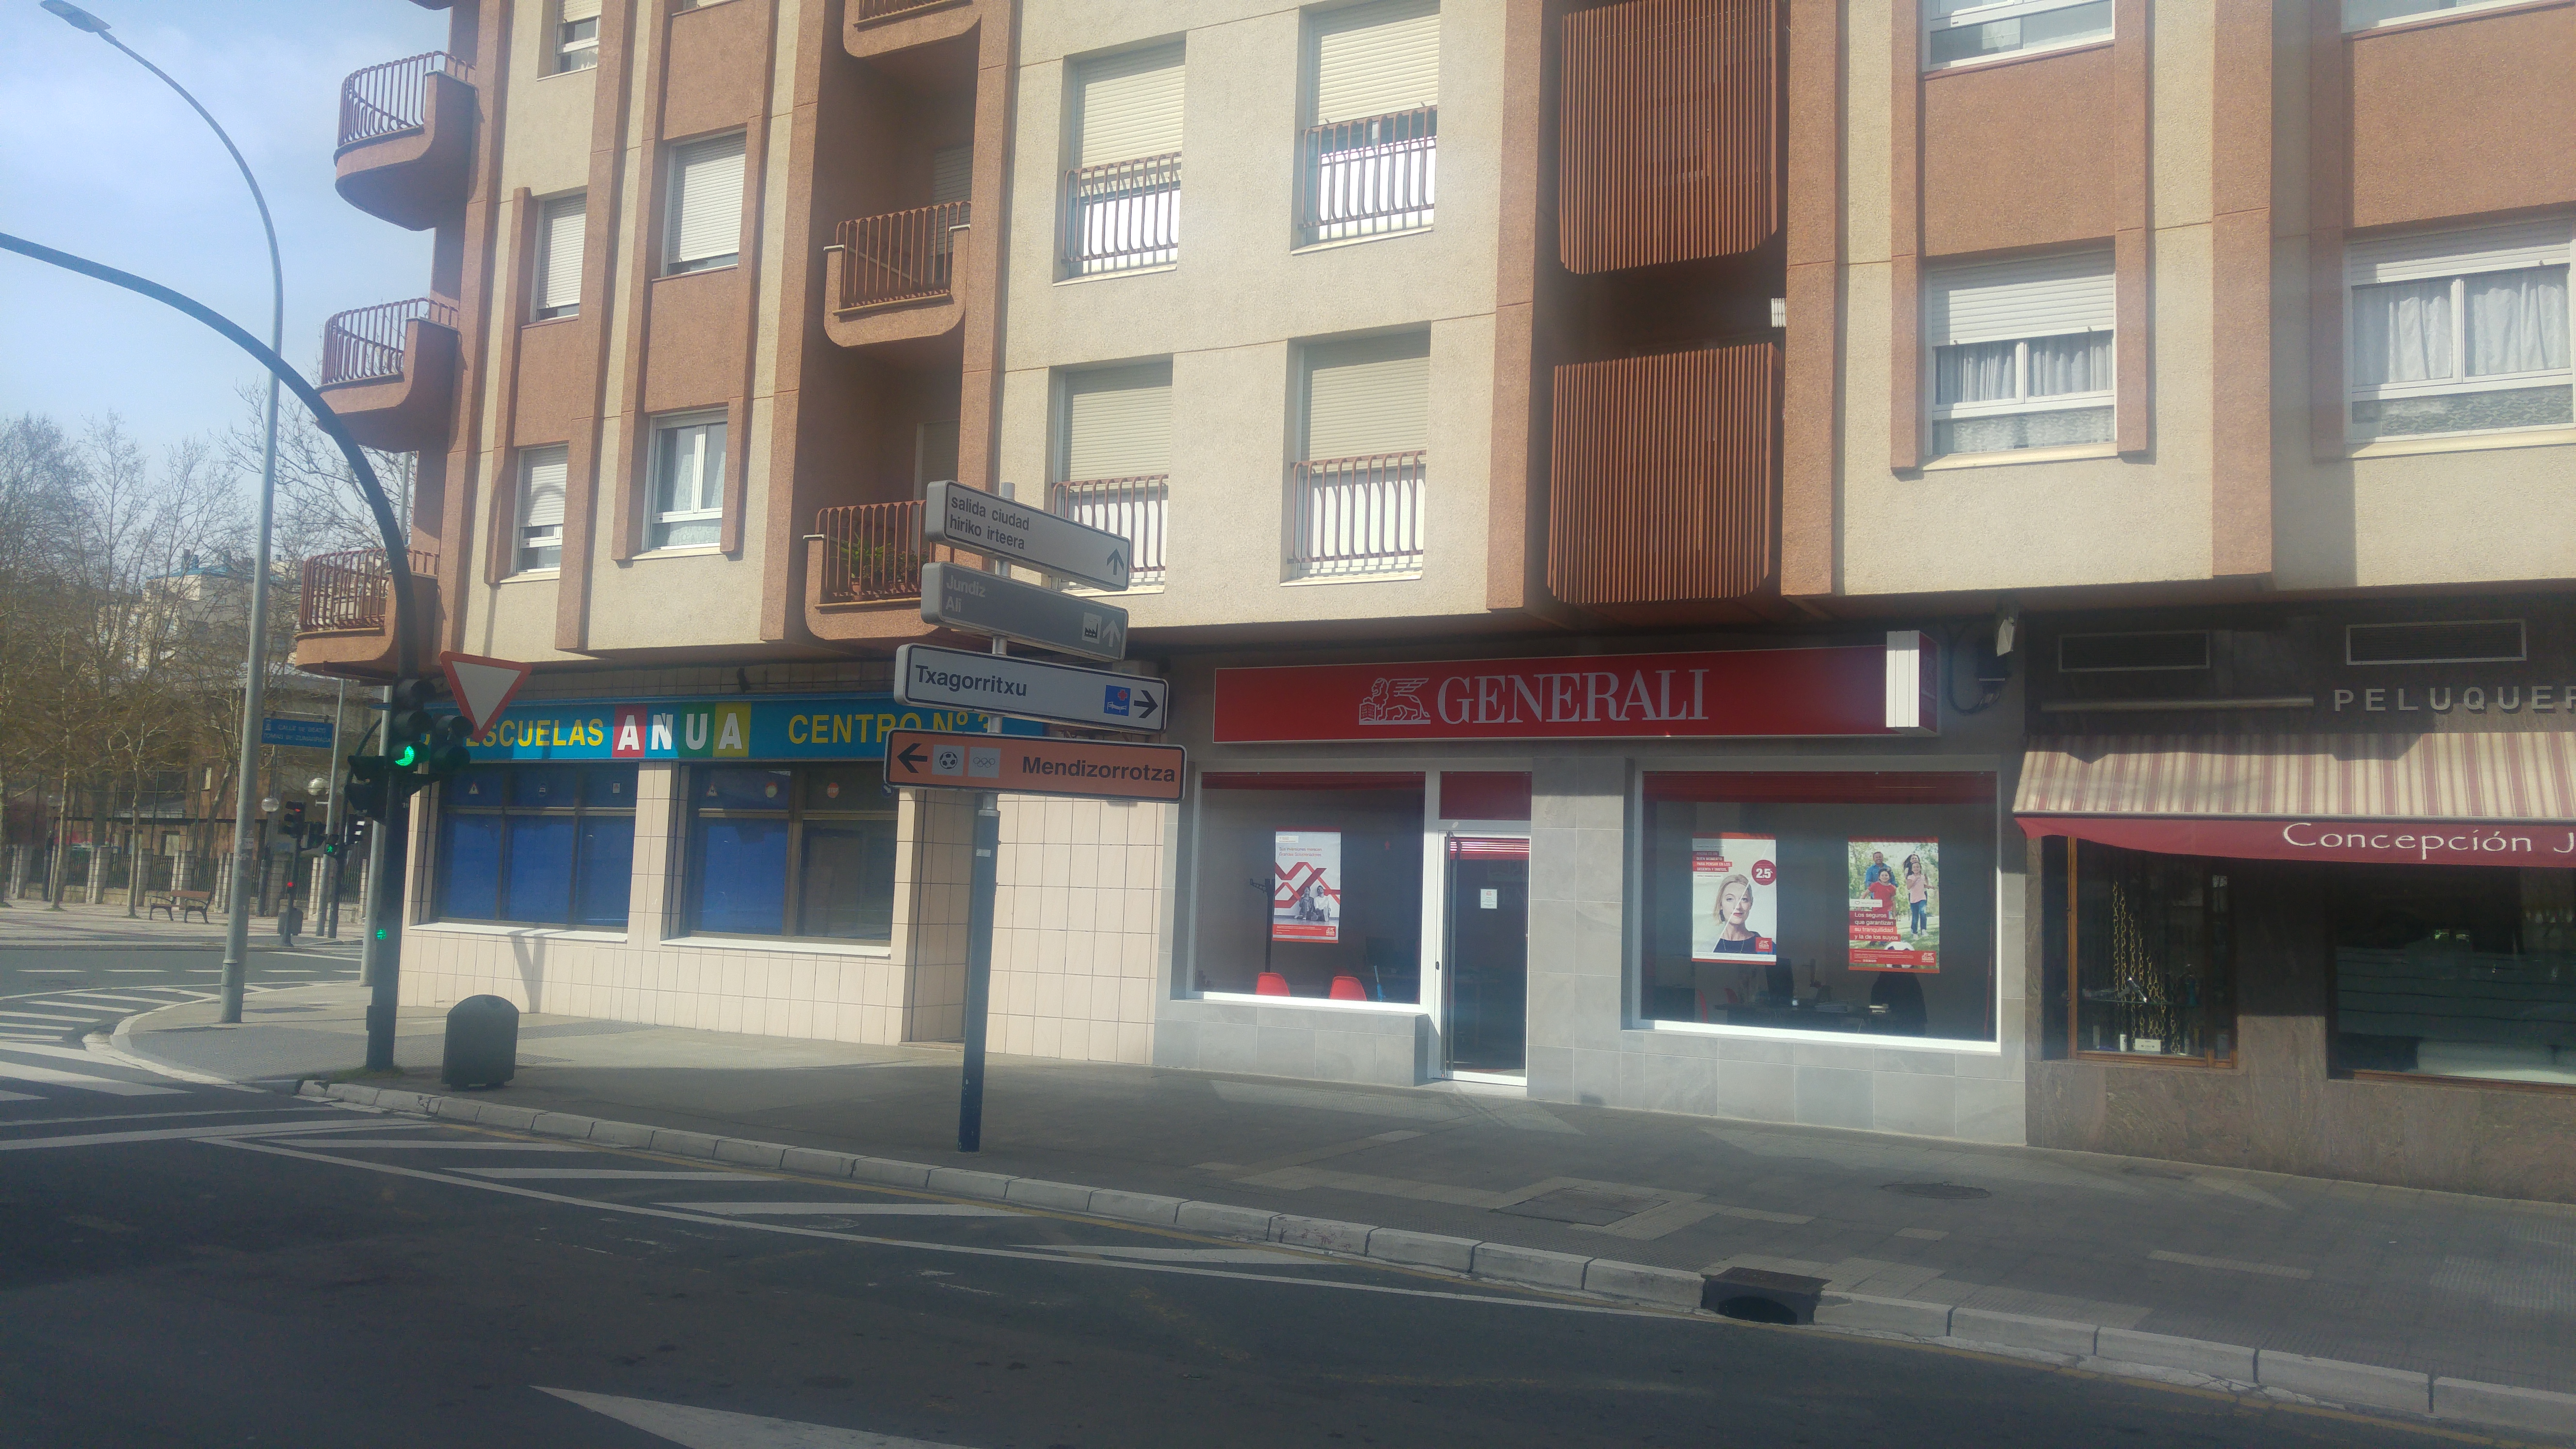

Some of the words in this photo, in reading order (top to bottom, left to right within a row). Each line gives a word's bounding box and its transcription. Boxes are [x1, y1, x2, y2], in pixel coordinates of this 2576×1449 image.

[951, 497, 986, 518] salida
[992, 509, 1030, 531] ciudad
[950, 514, 982, 537] hiriko
[987, 526, 1024, 549] irteera
[946, 575, 985, 597] Jundiz
[945, 596, 962, 612] Ali
[915, 664, 1027, 696] Txagorritxu
[1437, 669, 1709, 724] GENERALI
[1022, 756, 1175, 782] Mendizorrotza
[2283, 822, 2532, 860] Concepción
